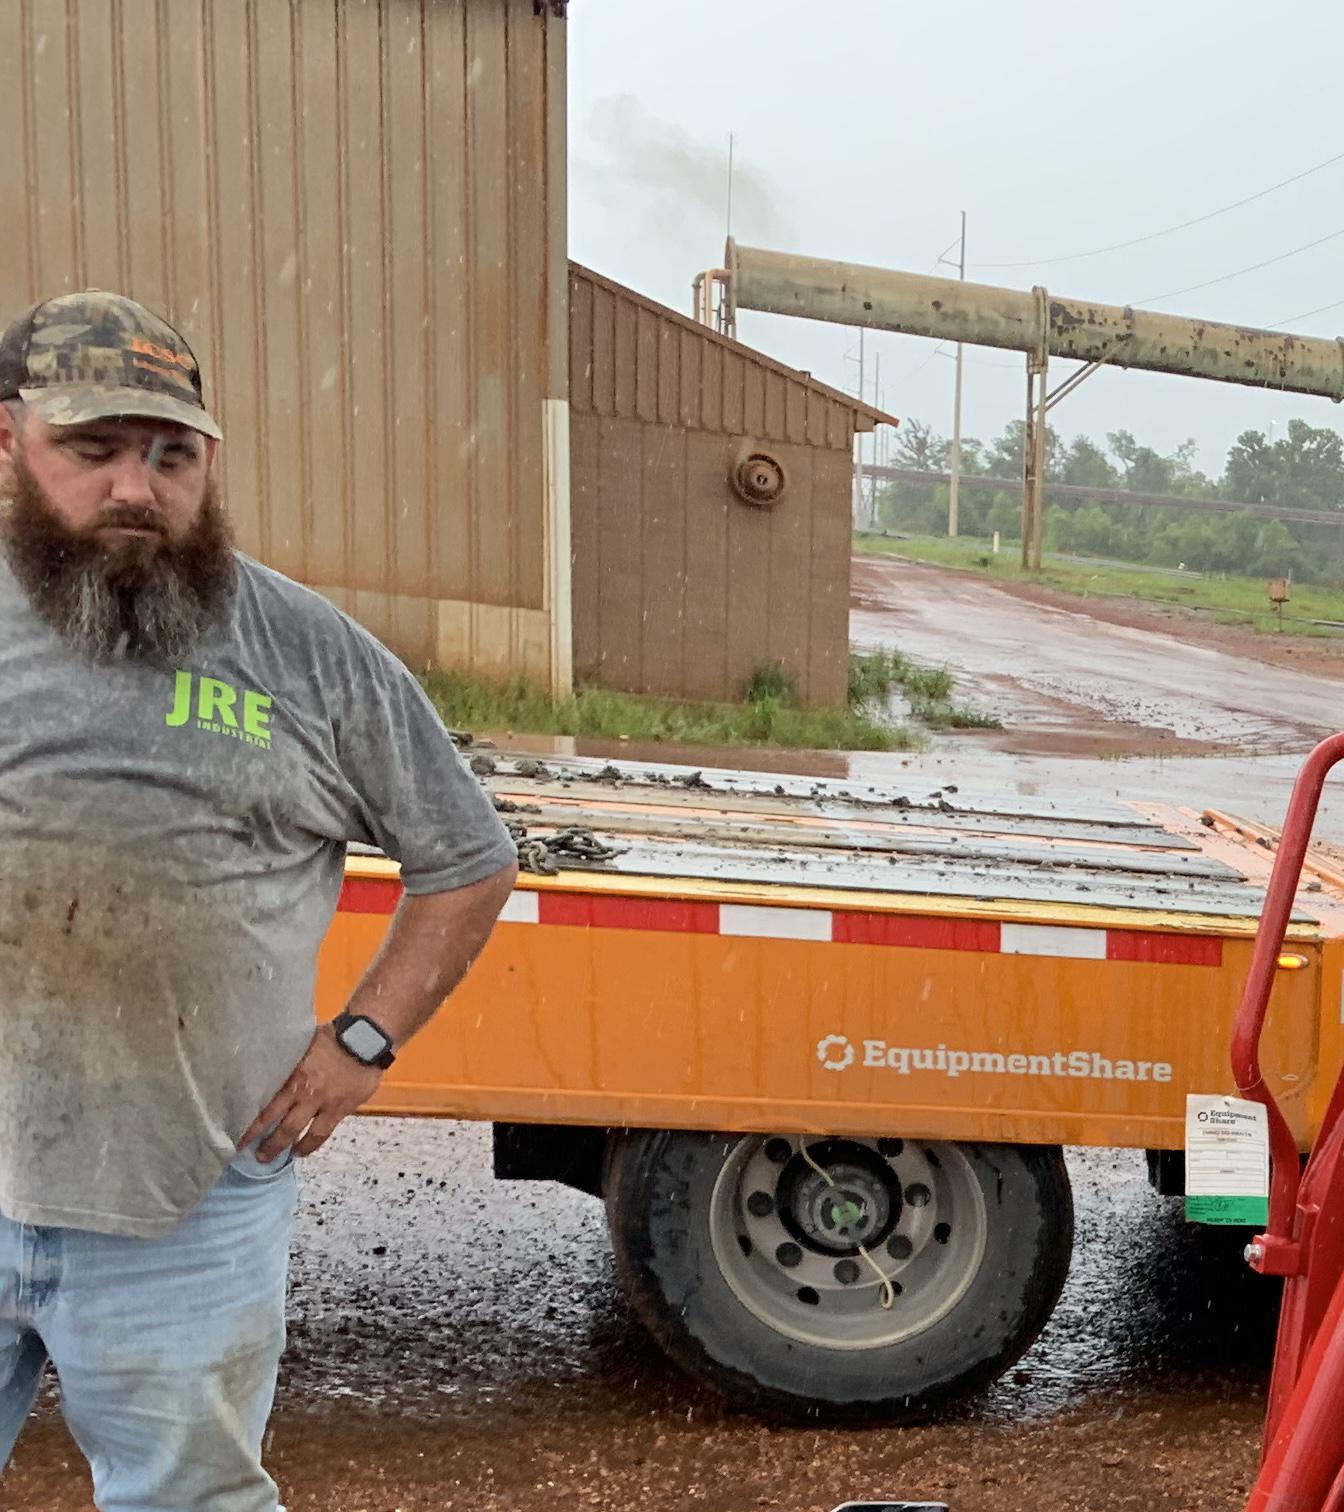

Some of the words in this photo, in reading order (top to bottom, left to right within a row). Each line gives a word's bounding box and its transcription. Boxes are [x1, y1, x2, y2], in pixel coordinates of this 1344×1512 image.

[166, 670, 272, 741] JRE
[862, 1040, 1173, 1082] EquipmentShare
[1210, 1110, 1257, 1121] Equipment
